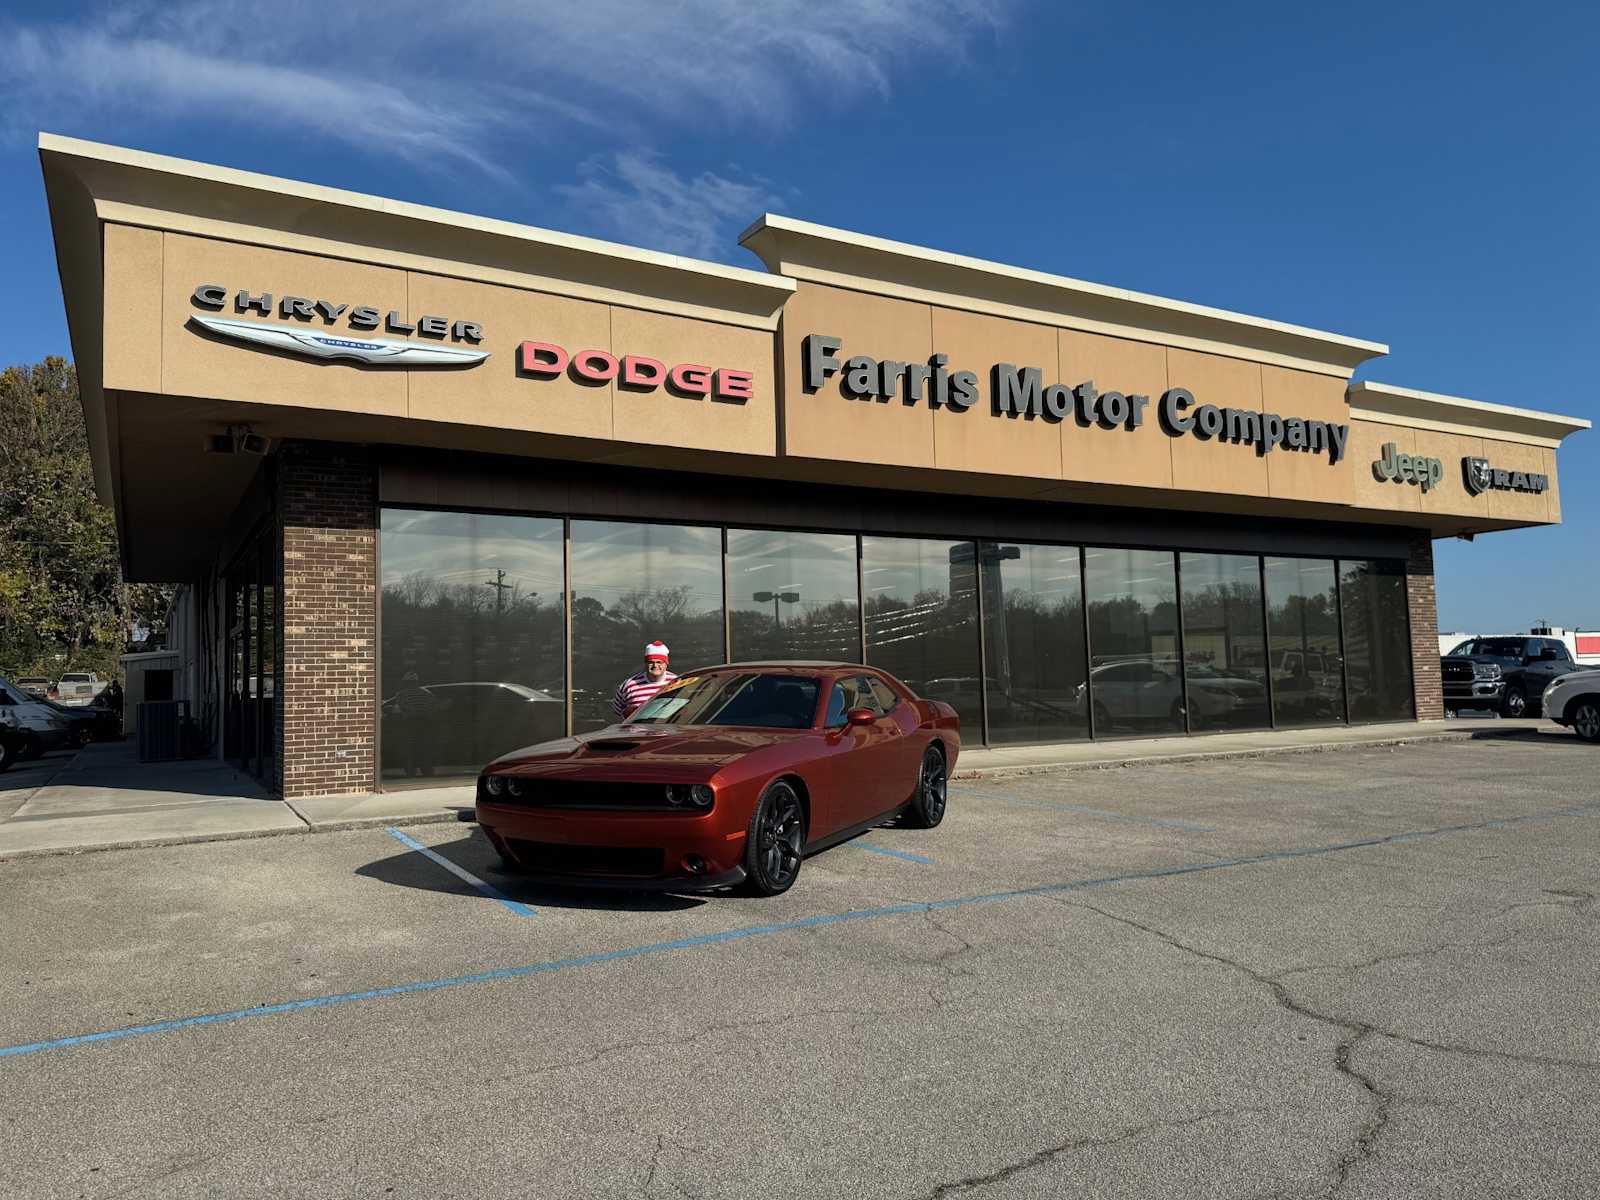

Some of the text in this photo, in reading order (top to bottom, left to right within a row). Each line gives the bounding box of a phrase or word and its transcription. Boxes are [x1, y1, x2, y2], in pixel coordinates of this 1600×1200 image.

[191, 284, 484, 344] CHRYSLER
[515, 340, 753, 405] DODGE
[801, 334, 1349, 465] Farris Motor Company
[1372, 442, 1443, 493] Jeep
[1489, 469, 1549, 494] RAM
